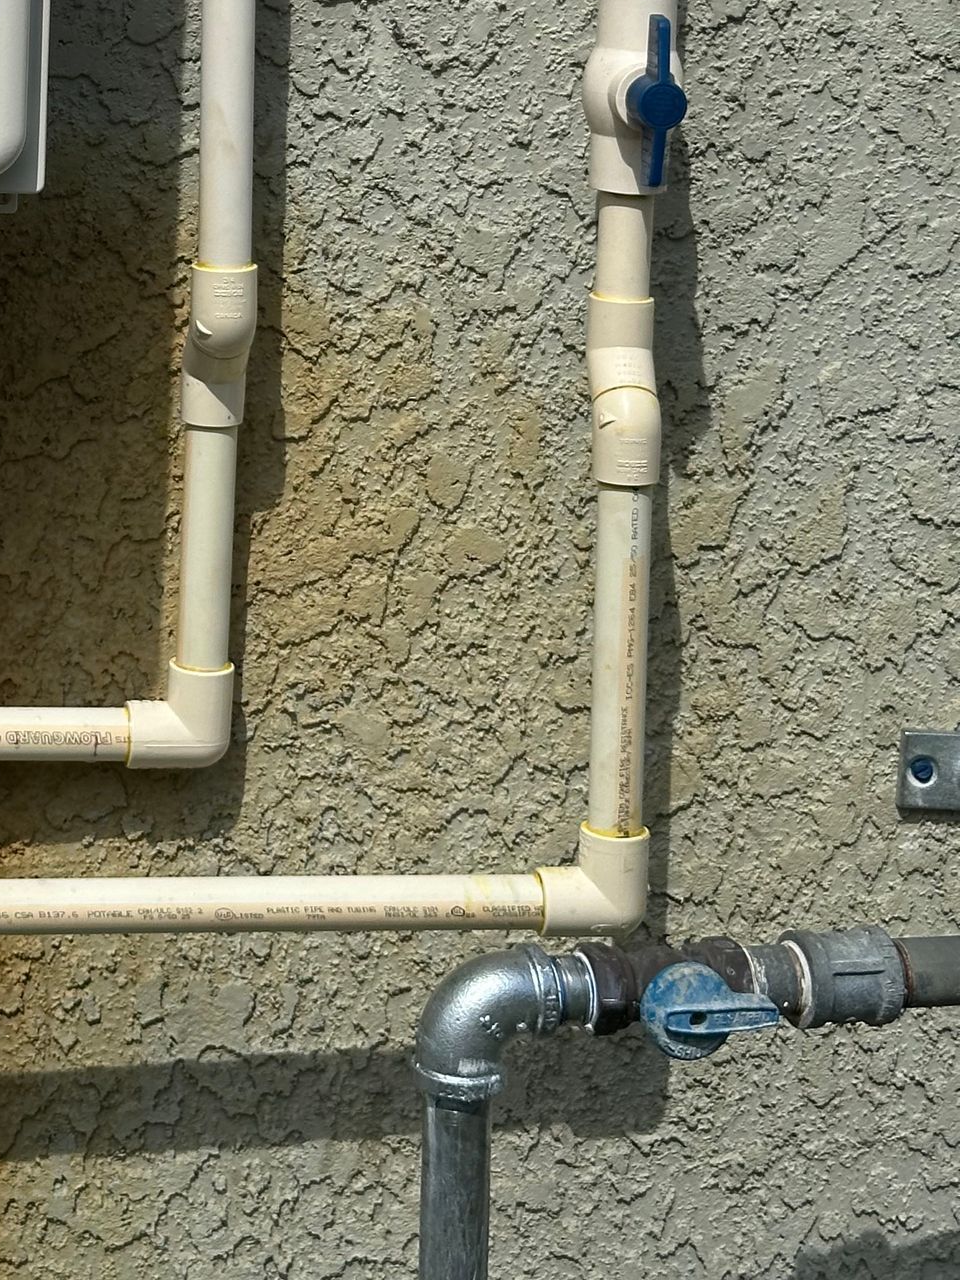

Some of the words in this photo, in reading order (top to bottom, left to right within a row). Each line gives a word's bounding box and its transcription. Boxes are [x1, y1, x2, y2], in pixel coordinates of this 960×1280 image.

[631, 507, 639, 540] RATED
[6, 731, 112, 745] FLOWGUARD
[14, 911, 34, 919] CSA
[39, 910, 79, 919] B137.6
[87, 909, 134, 919] POTABLE
